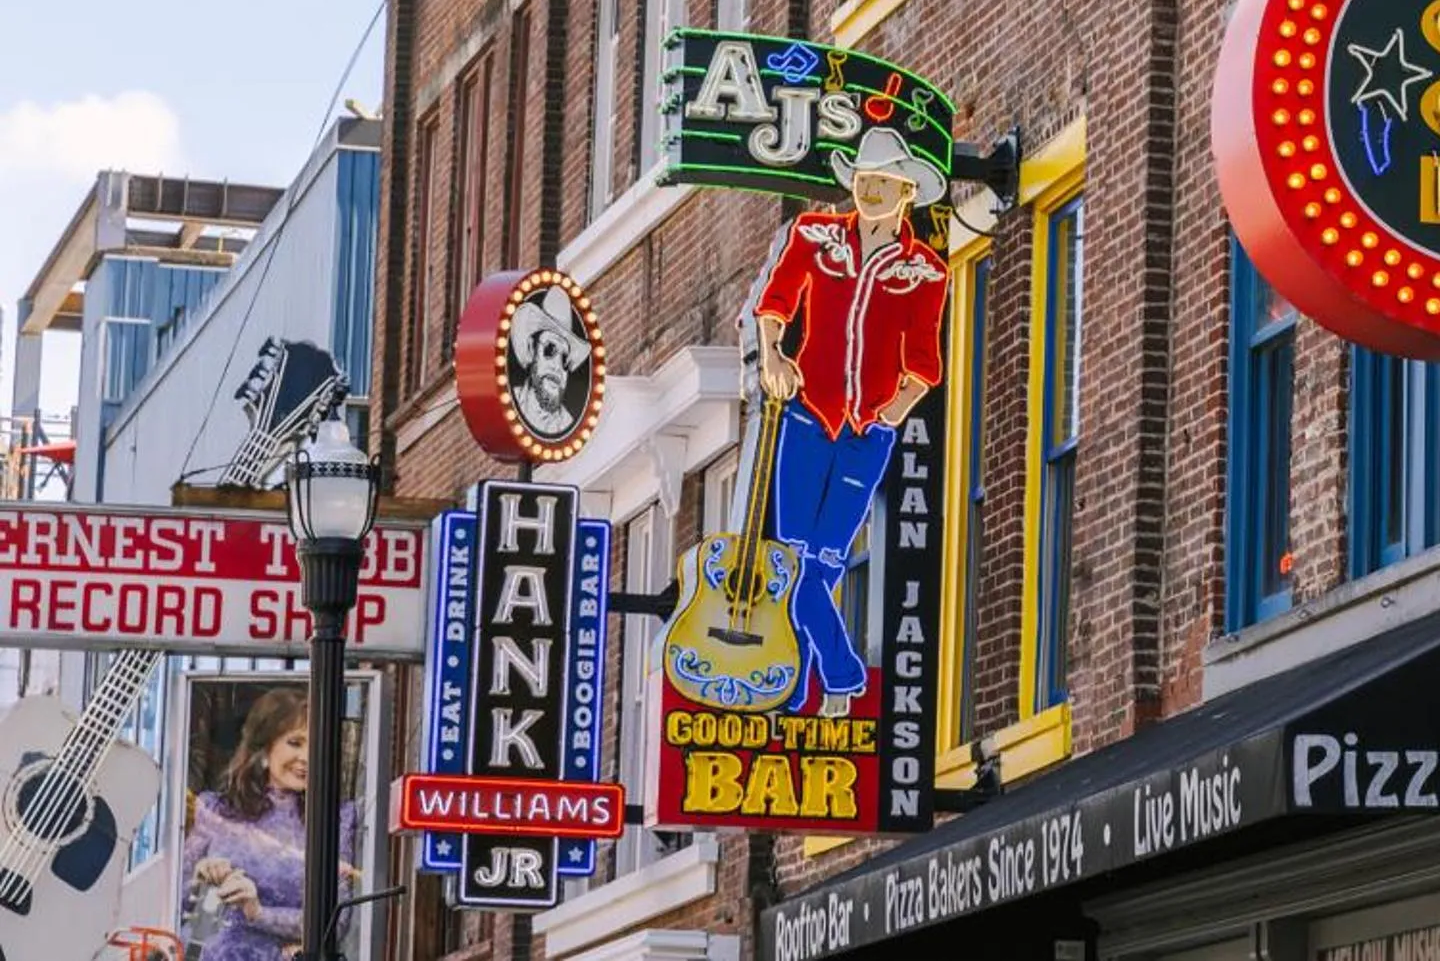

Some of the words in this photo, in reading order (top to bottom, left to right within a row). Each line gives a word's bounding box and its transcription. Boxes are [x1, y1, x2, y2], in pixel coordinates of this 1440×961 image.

[900, 416, 930, 550] ALAN
[260, 523, 416, 582] TB
[580, 552, 601, 618] BAR
[10, 578, 223, 639] RECORD
[447, 546, 471, 643] DRINK
[488, 493, 558, 769] HANK
[440, 680, 463, 744] EAT
[573, 627, 596, 751] BOOGIE
[890, 579, 925, 818] JACKSON
[666, 710, 768, 749] GOOD
[777, 714, 877, 753] TIME
[418, 788, 611, 825] WILLIAMS
[681, 750, 859, 820] BAR
[474, 846, 545, 889] JR
[775, 901, 826, 961] Rooftop
[828, 892, 854, 951] Bar
[885, 870, 924, 935] Pizza
[928, 850, 983, 921] Bakers
[987, 834, 1036, 904] Since
[1041, 808, 1085, 888] 1974
[1134, 783, 1176, 857] Live
[1179, 754, 1243, 843] Music
